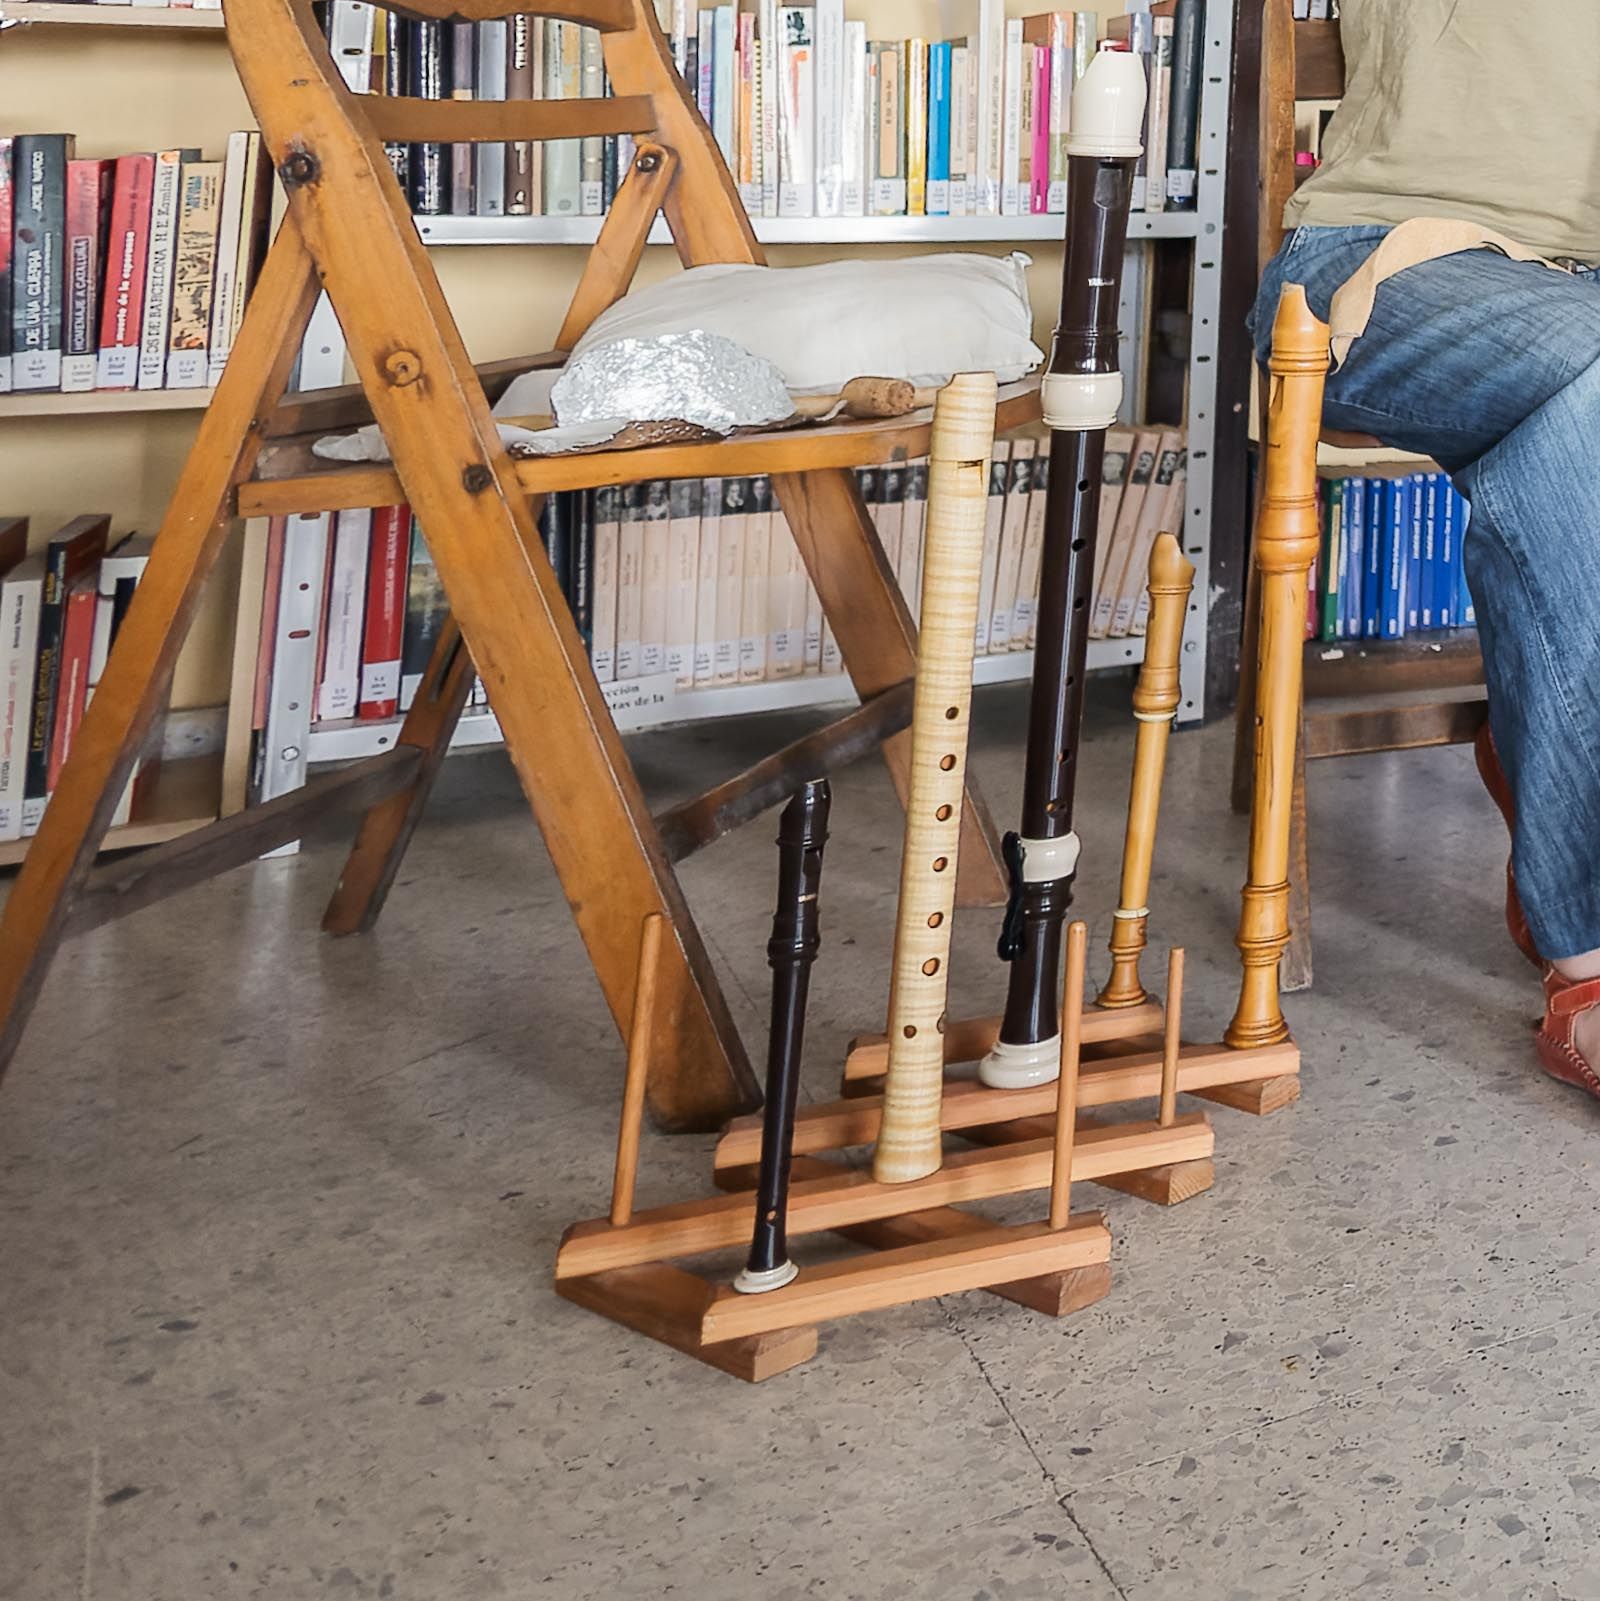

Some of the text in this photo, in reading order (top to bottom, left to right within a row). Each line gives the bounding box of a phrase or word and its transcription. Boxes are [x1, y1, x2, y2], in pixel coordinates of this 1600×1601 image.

[73, 239, 87, 289] CATALUÑA
[121, 231, 137, 279] esperanza
[148, 165, 173, 336] DE BARCELONA Kaminski
[25, 250, 42, 344] DE UNA GUERRA
[73, 298, 86, 351] HOMENAJE
[114, 307, 129, 341] muerte
